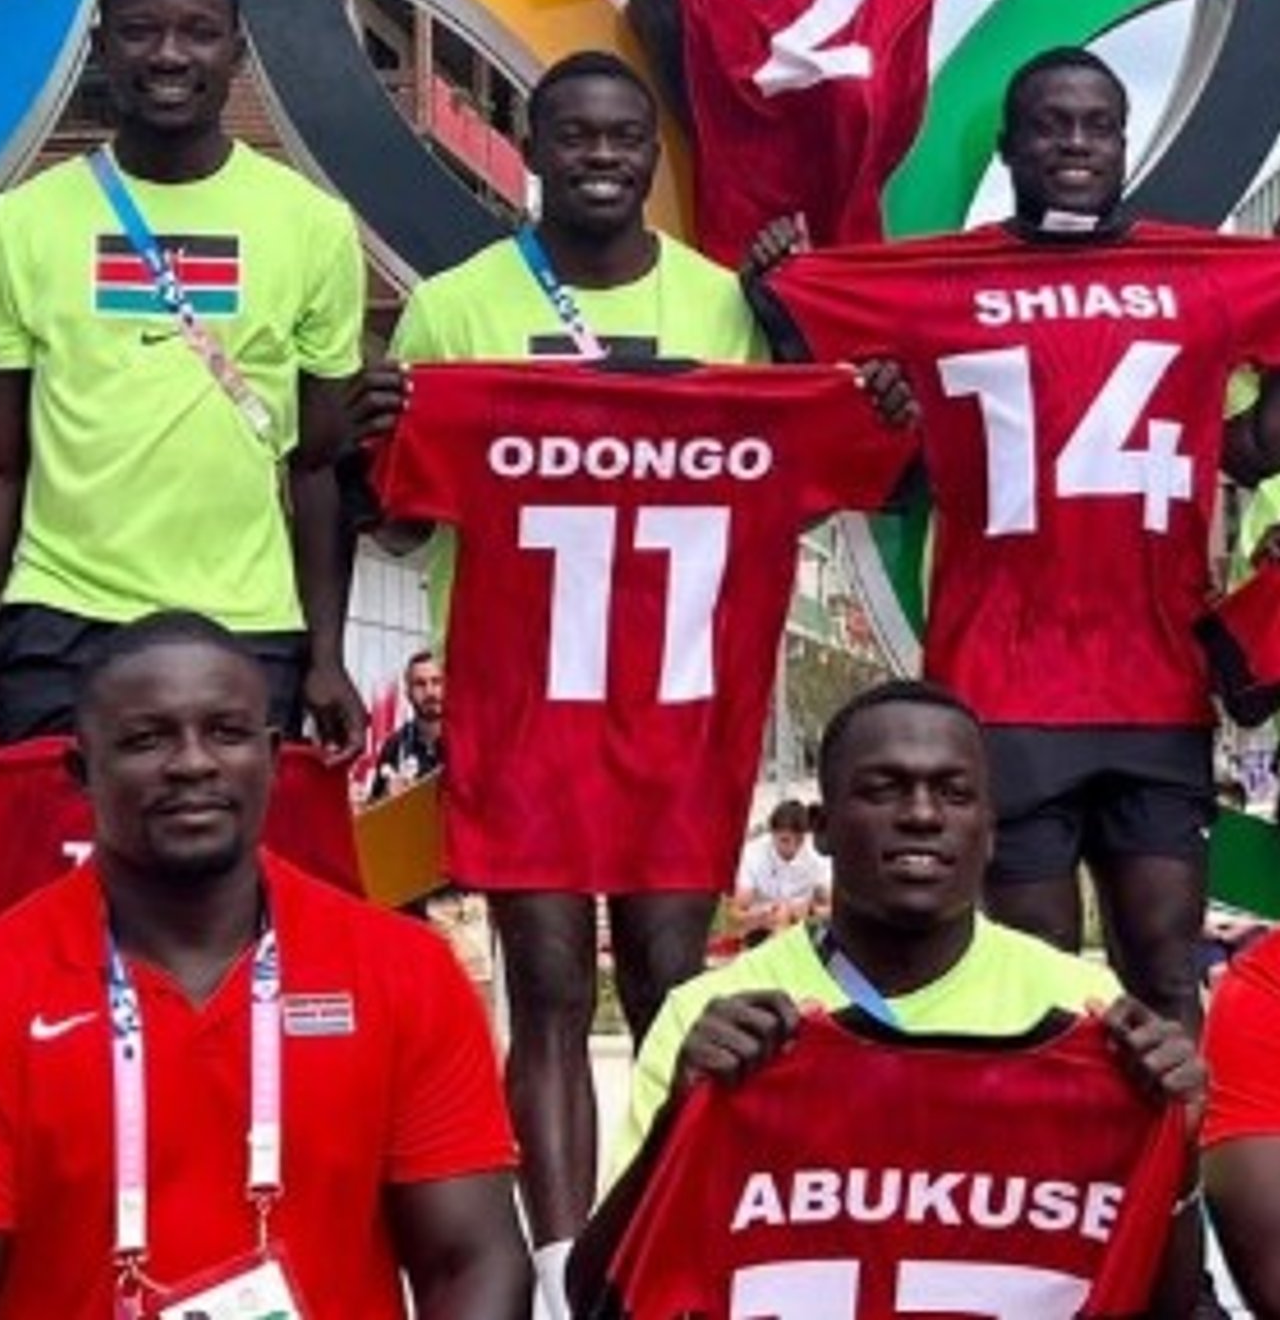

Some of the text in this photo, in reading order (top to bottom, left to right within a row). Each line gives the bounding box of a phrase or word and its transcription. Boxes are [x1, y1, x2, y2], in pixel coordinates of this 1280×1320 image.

[974, 283, 1178, 327] SHIASI
[488, 436, 773, 480] ODONGO
[935, 340, 1193, 538] 14
[519, 505, 732, 703] 11
[730, 1168, 1125, 1243] ABUKUSE
